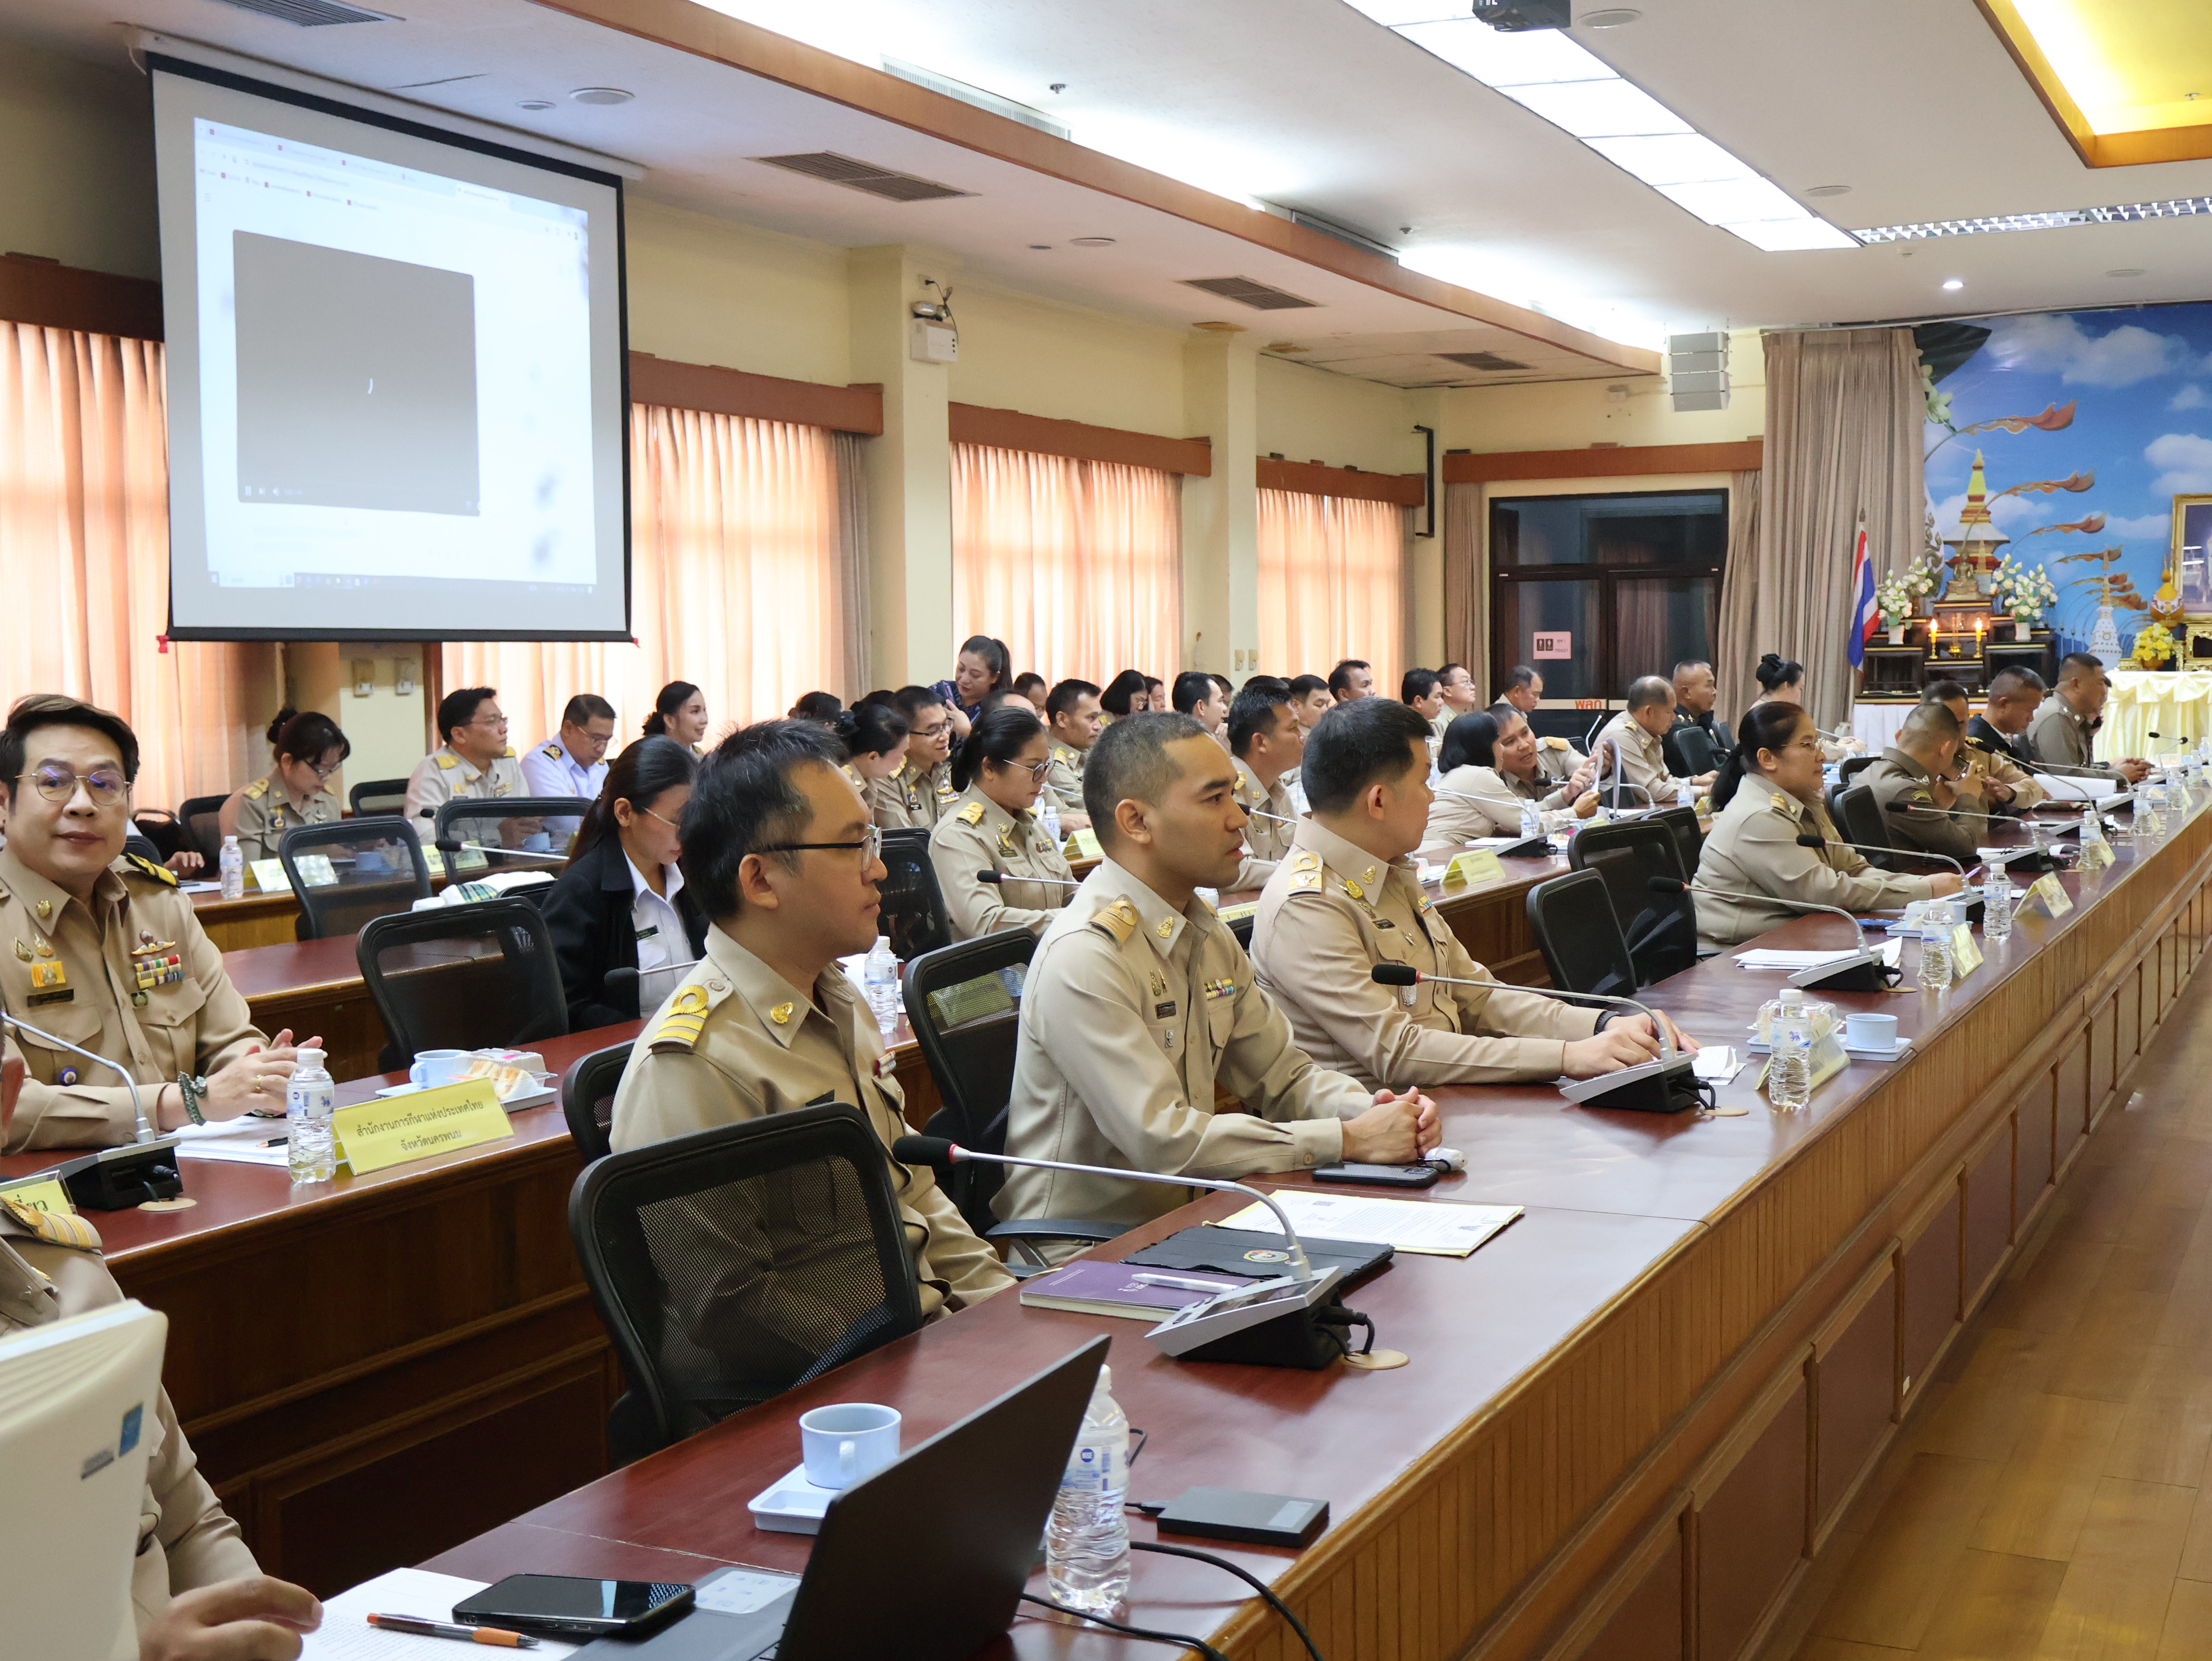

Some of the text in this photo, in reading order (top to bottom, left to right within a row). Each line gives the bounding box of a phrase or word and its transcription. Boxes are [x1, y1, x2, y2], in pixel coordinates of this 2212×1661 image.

[357, 1100, 483, 1137] สำนักงานการกีฬาแห่งประเทศไทย
